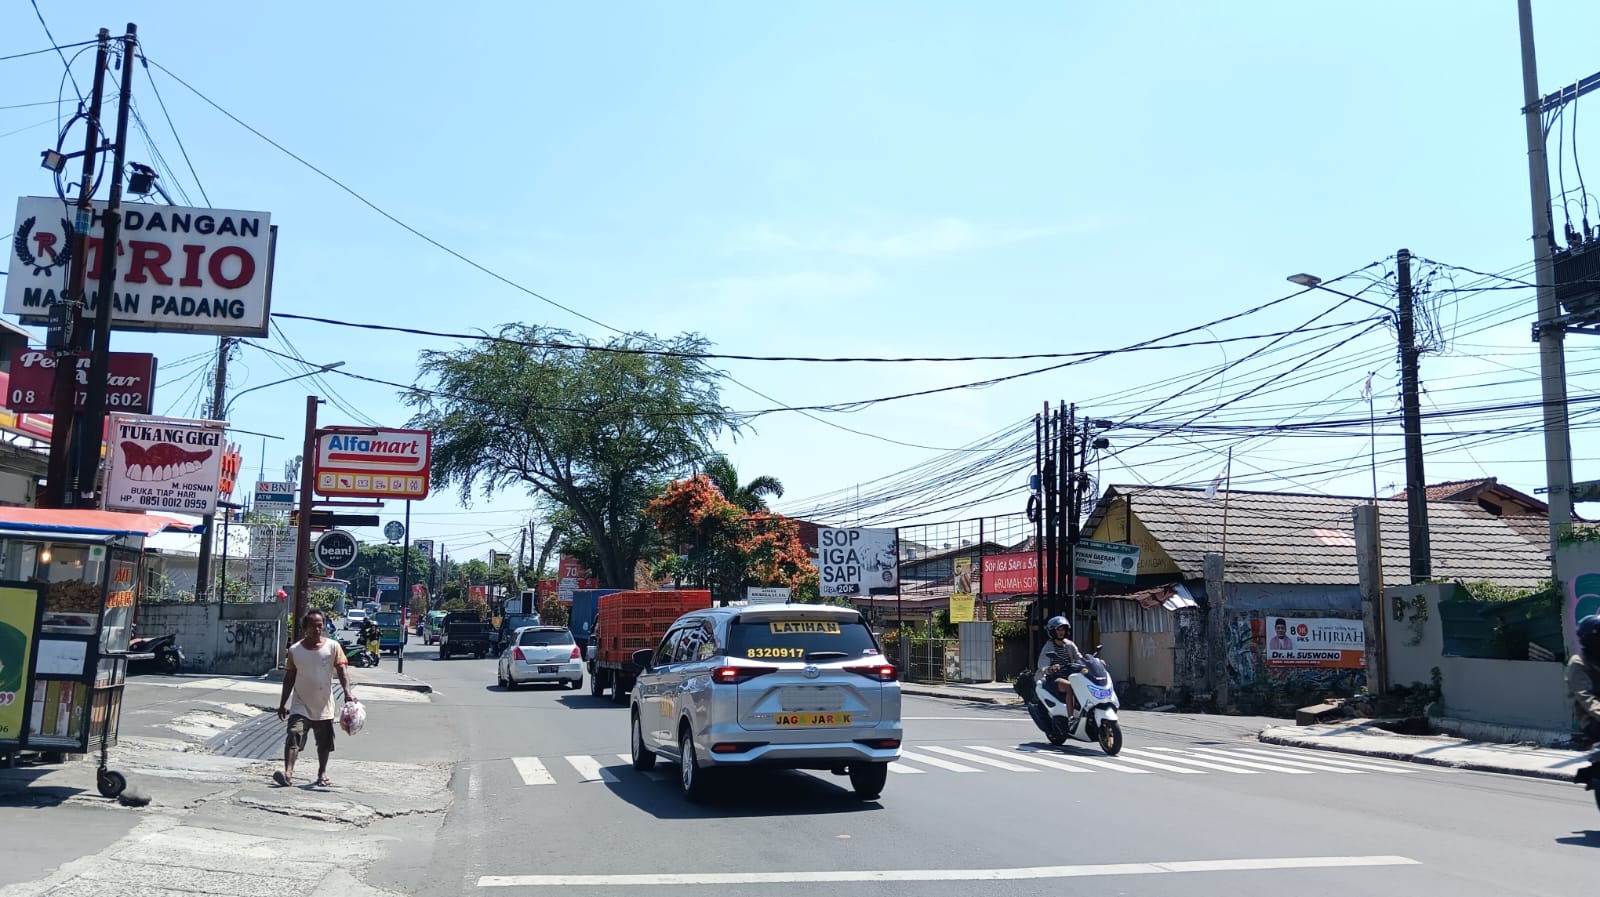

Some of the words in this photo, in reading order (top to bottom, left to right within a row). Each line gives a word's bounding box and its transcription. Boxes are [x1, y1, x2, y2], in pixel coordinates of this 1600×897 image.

[91, 208, 259, 237] HDANGAN
[34, 232, 57, 257] R
[87, 237, 255, 290] TRIO
[151, 296, 245, 319] PADANG
[120, 425, 183, 443] TUKANG
[186, 430, 220, 446] GIGI
[328, 435, 418, 454] Alfamart
[131, 487, 153, 495] BUKA
[157, 489, 174, 497] TIAP
[176, 490, 196, 499] HARI
[183, 483, 213, 492] HOSNAN
[272, 483, 291, 492] BNI
[140, 496, 159, 506] 0851
[162, 497, 181, 507] 0012
[184, 499, 207, 509] 0959
[822, 530, 860, 547] SOP
[321, 545, 352, 556] bean!
[823, 548, 860, 565] IGA
[823, 566, 861, 582] SAPI
[837, 584, 855, 593] 20K
[773, 622, 838, 633] LATIHAN
[1312, 630, 1363, 643] HIJRIAH
[746, 648, 804, 658] 8320917
[1272, 652, 1285, 660] Dr.
[1287, 652, 1295, 660] H.
[1297, 652, 1341, 660] SUSWONO
[776, 715, 805, 725] JAG
[811, 714, 851, 724] JARK
